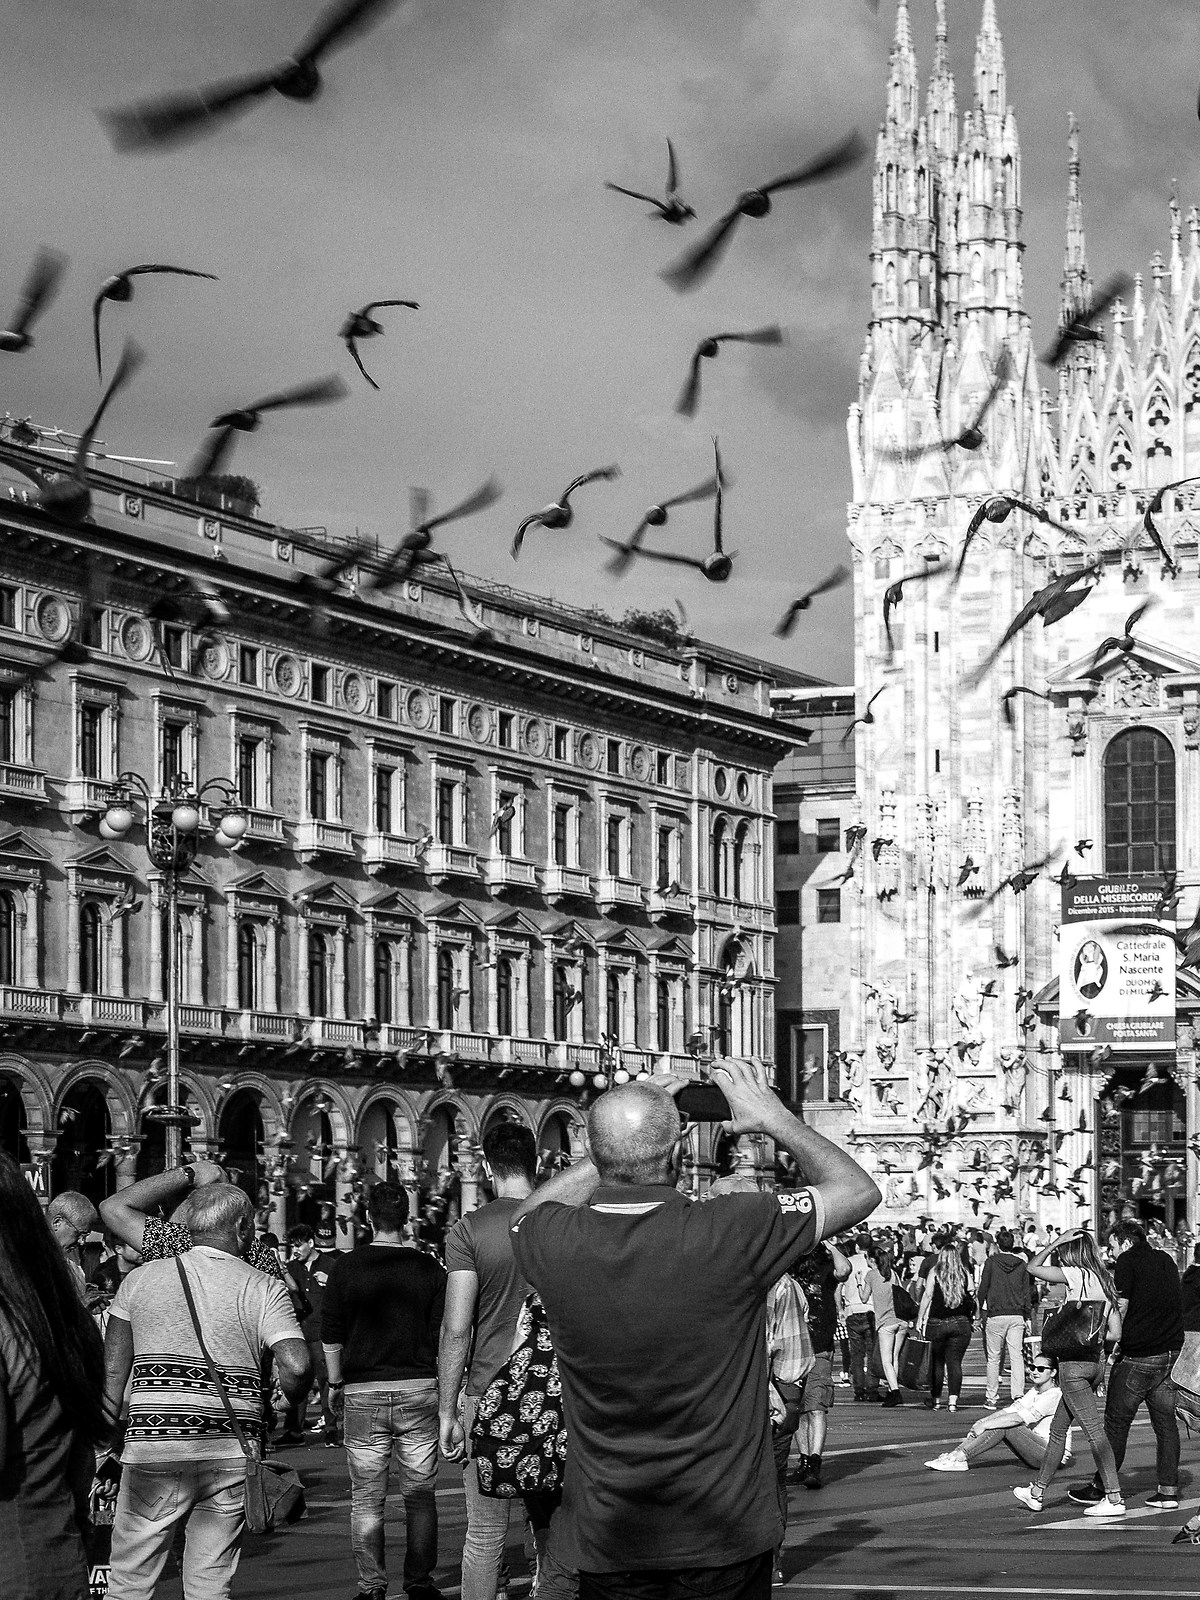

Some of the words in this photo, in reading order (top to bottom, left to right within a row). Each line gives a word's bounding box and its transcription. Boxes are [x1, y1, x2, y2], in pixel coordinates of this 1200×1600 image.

[1098, 883, 1139, 894] GIUBILEO
[1073, 895, 1100, 905] DELLA
[1100, 893, 1163, 904] MISERICORDIA
[1067, 906, 1098, 915] Dicembre
[1098, 906, 1115, 914] 2015
[1119, 905, 1154, 913] Novembre
[1116, 940, 1167, 950] Cattedrale
[1122, 953, 1132, 963] S.
[1133, 952, 1160, 962] Maria
[1119, 965, 1164, 975] Nascente
[1126, 979, 1158, 987] DUOMO
[1119, 988, 1129, 996] DI
[1106, 1022, 1130, 1030] CHIESA
[1130, 1021, 1165, 1030] GIUBILARE
[1113, 1030, 1135, 1038] PORTA
[1135, 1030, 1158, 1038] SANTA
